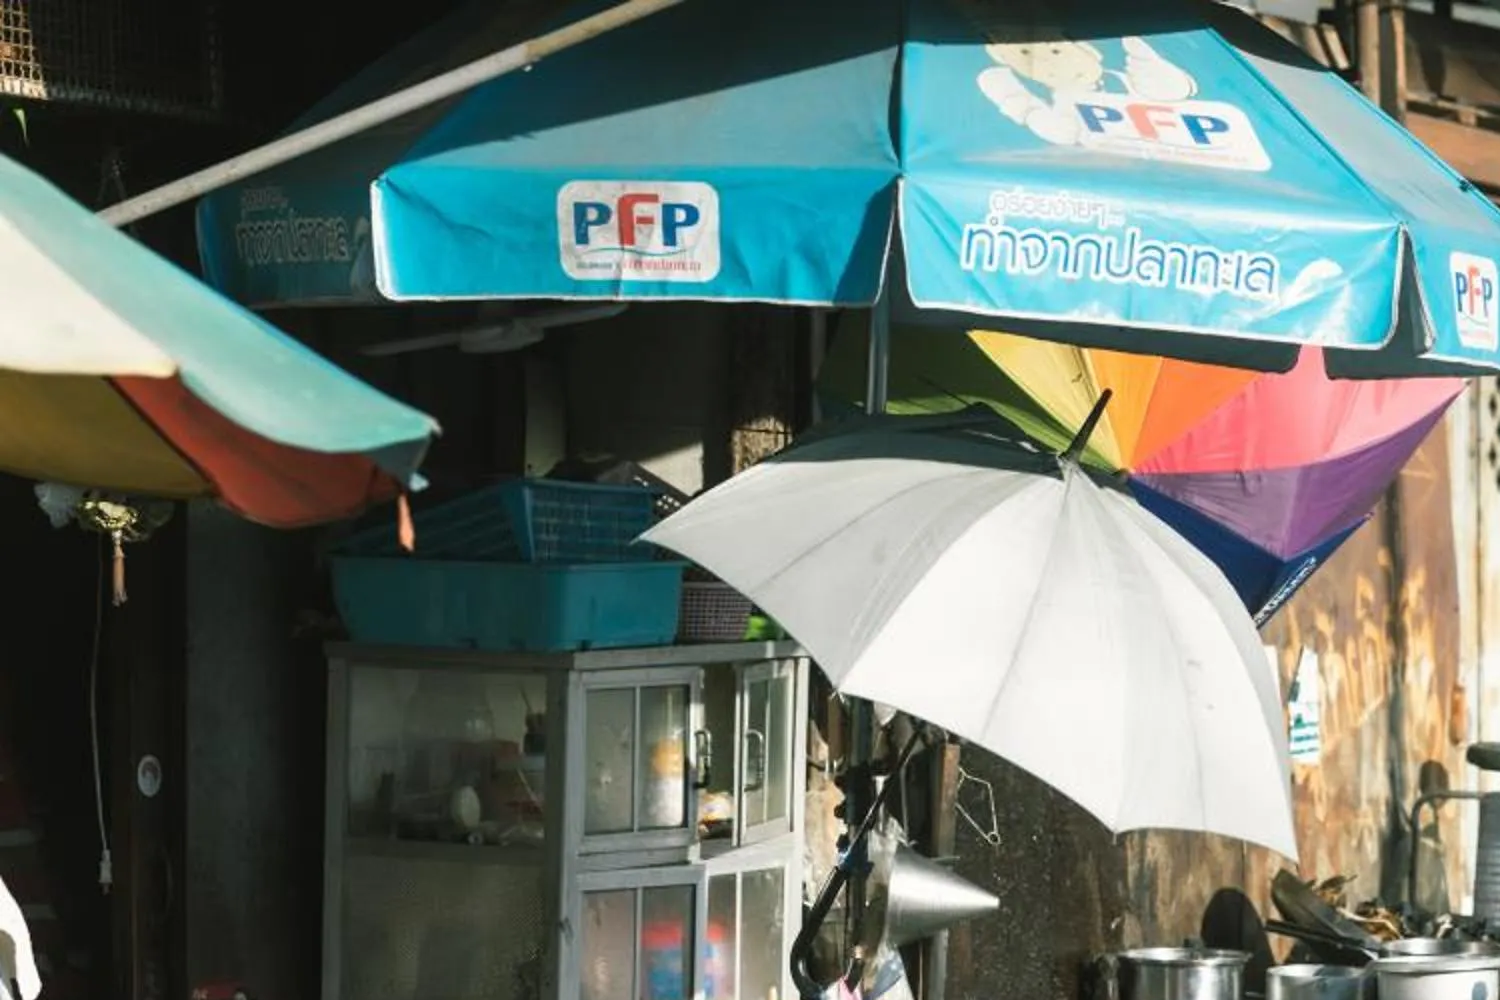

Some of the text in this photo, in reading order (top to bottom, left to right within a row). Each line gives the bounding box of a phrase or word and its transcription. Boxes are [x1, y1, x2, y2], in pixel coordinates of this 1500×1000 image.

[1075, 103, 1230, 145] PFP
[573, 193, 700, 247] PFP
[964, 215, 1276, 294] ทำจากปลาทะเล
[1455, 266, 1493, 318] PFP
